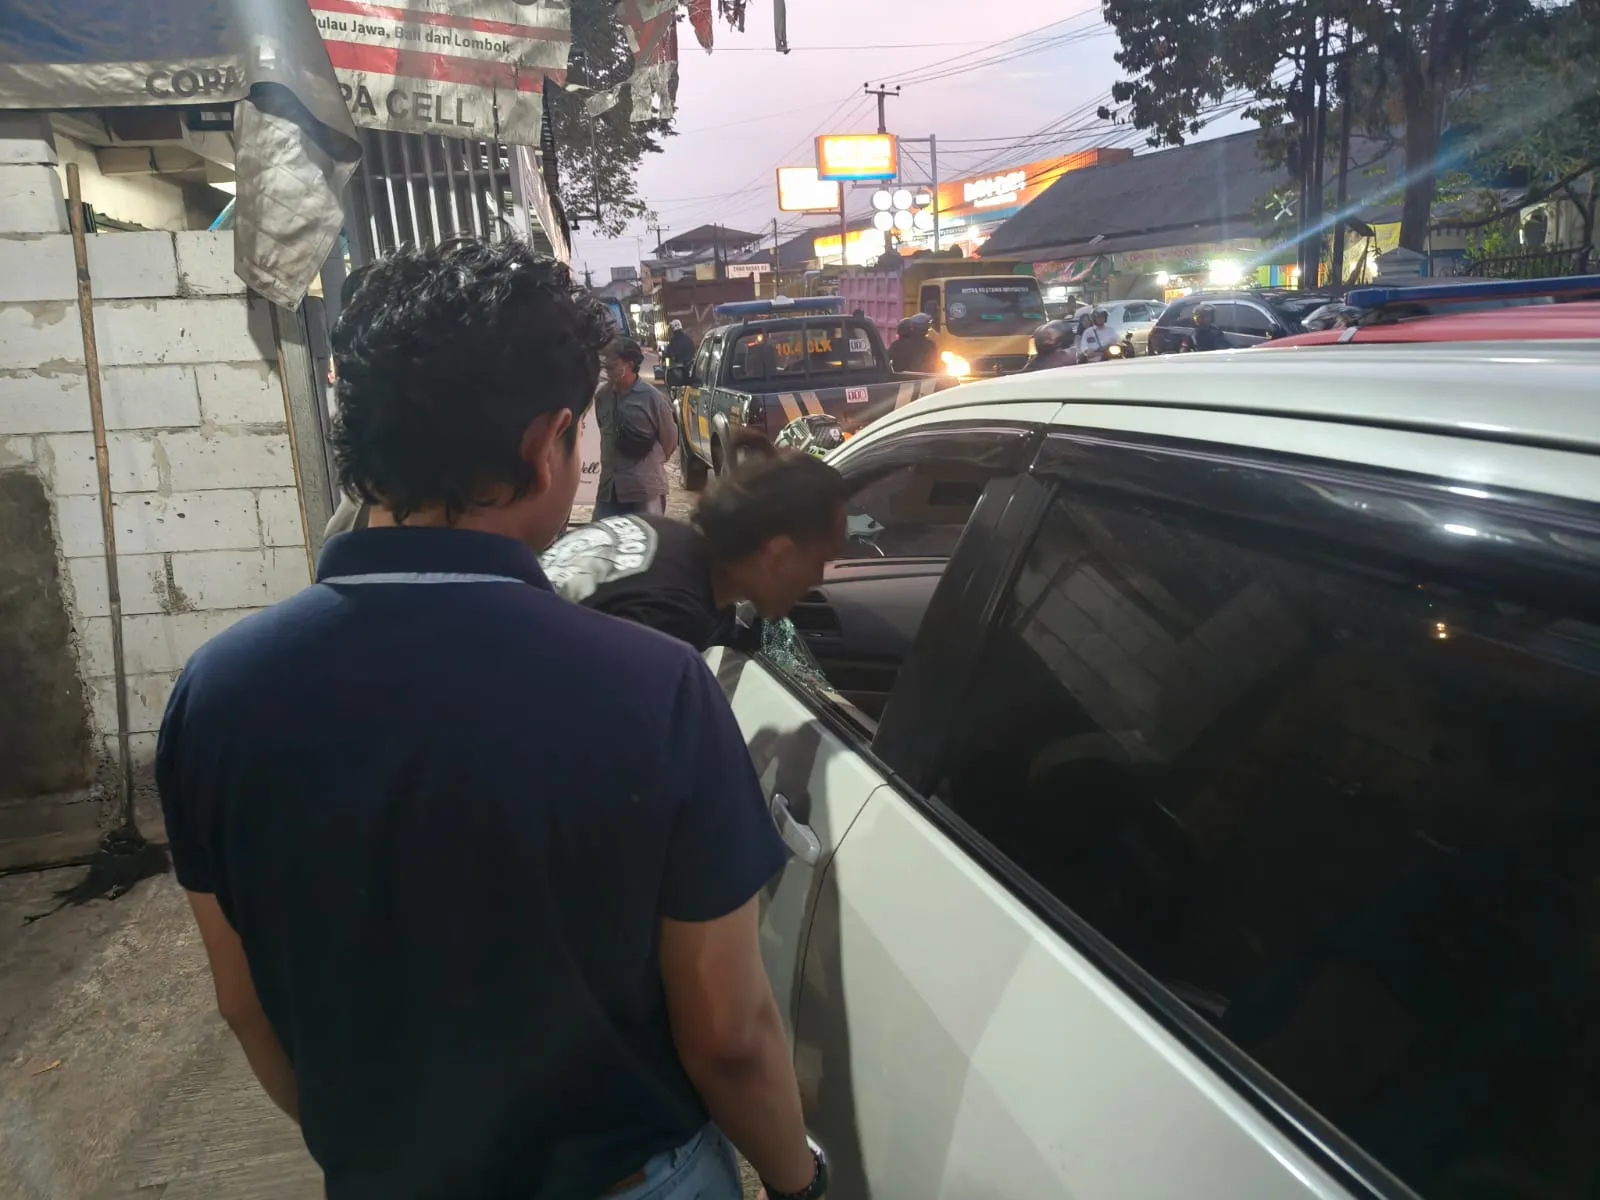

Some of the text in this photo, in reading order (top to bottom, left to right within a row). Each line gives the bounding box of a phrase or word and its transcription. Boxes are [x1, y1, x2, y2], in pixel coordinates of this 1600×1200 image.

[316, 15, 511, 55] ulau Jawa, Bali dan Lombok
[146, 65, 242, 99] COPA
[385, 88, 475, 128] CELL
